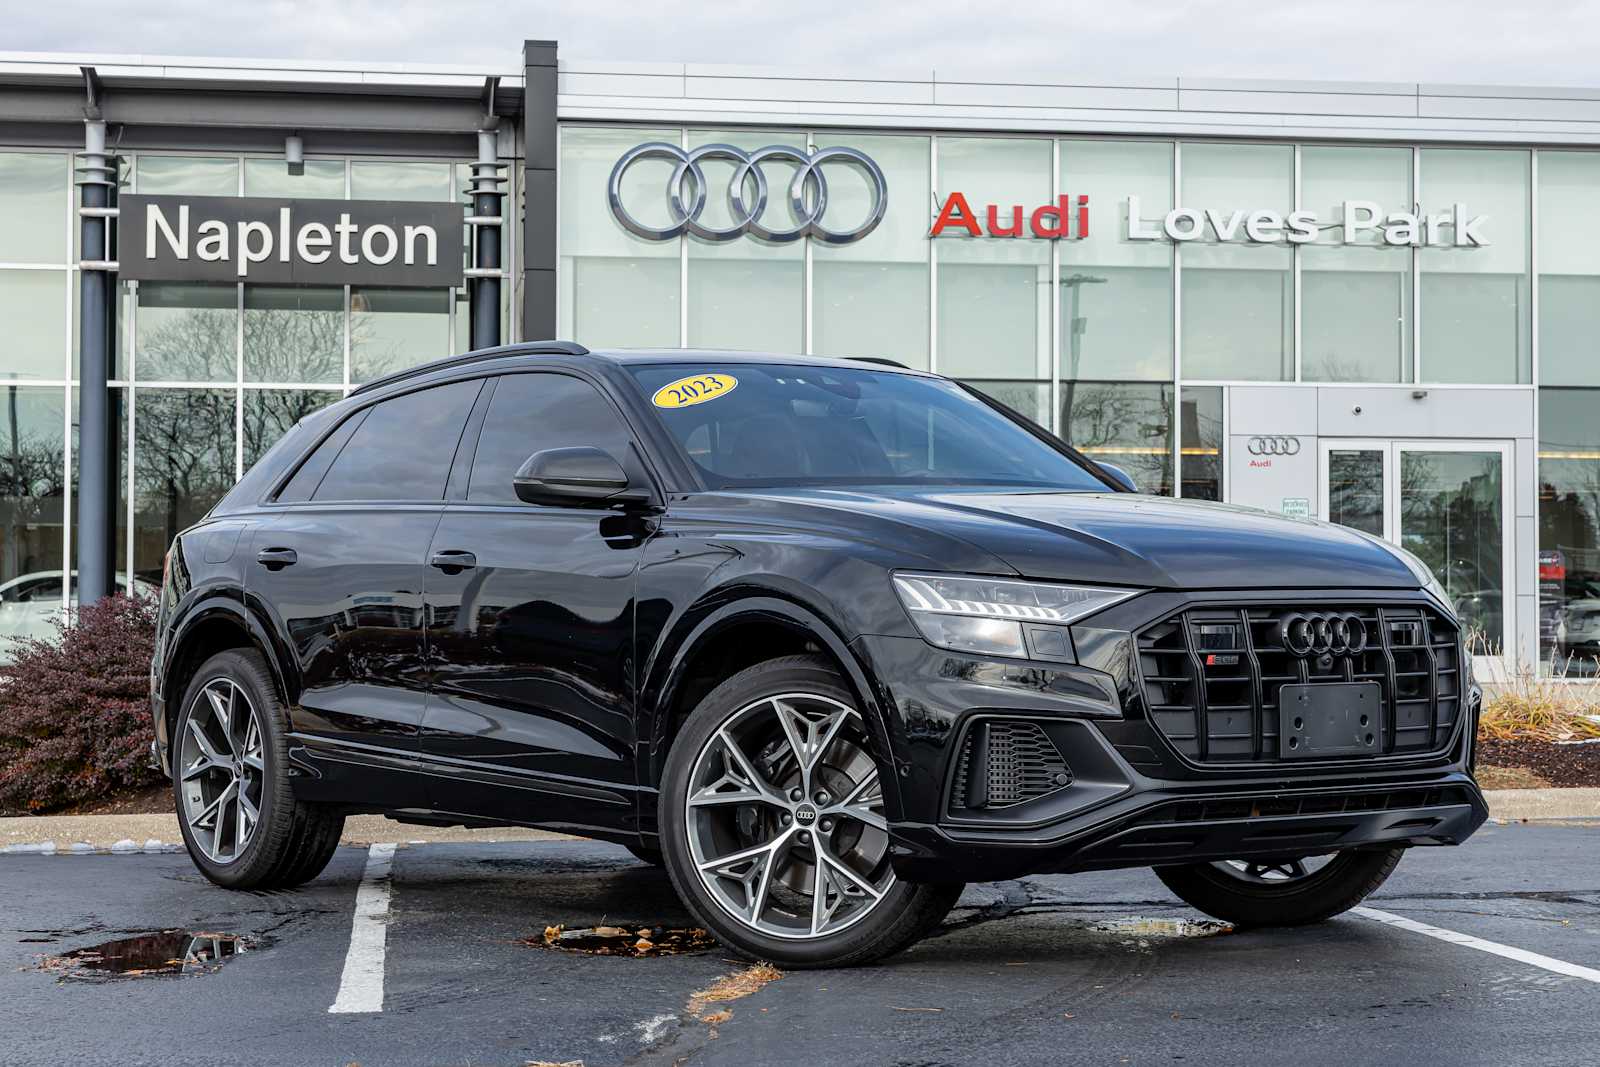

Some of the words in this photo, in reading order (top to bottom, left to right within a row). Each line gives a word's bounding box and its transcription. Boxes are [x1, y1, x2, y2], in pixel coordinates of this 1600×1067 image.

[145, 204, 437, 276] Napleton
[930, 192, 1089, 239] Audi
[1127, 196, 1319, 244] Loves
[1343, 200, 1488, 247] Park
[668, 377, 723, 404] 2023
[1249, 460, 1271, 468] Audi
